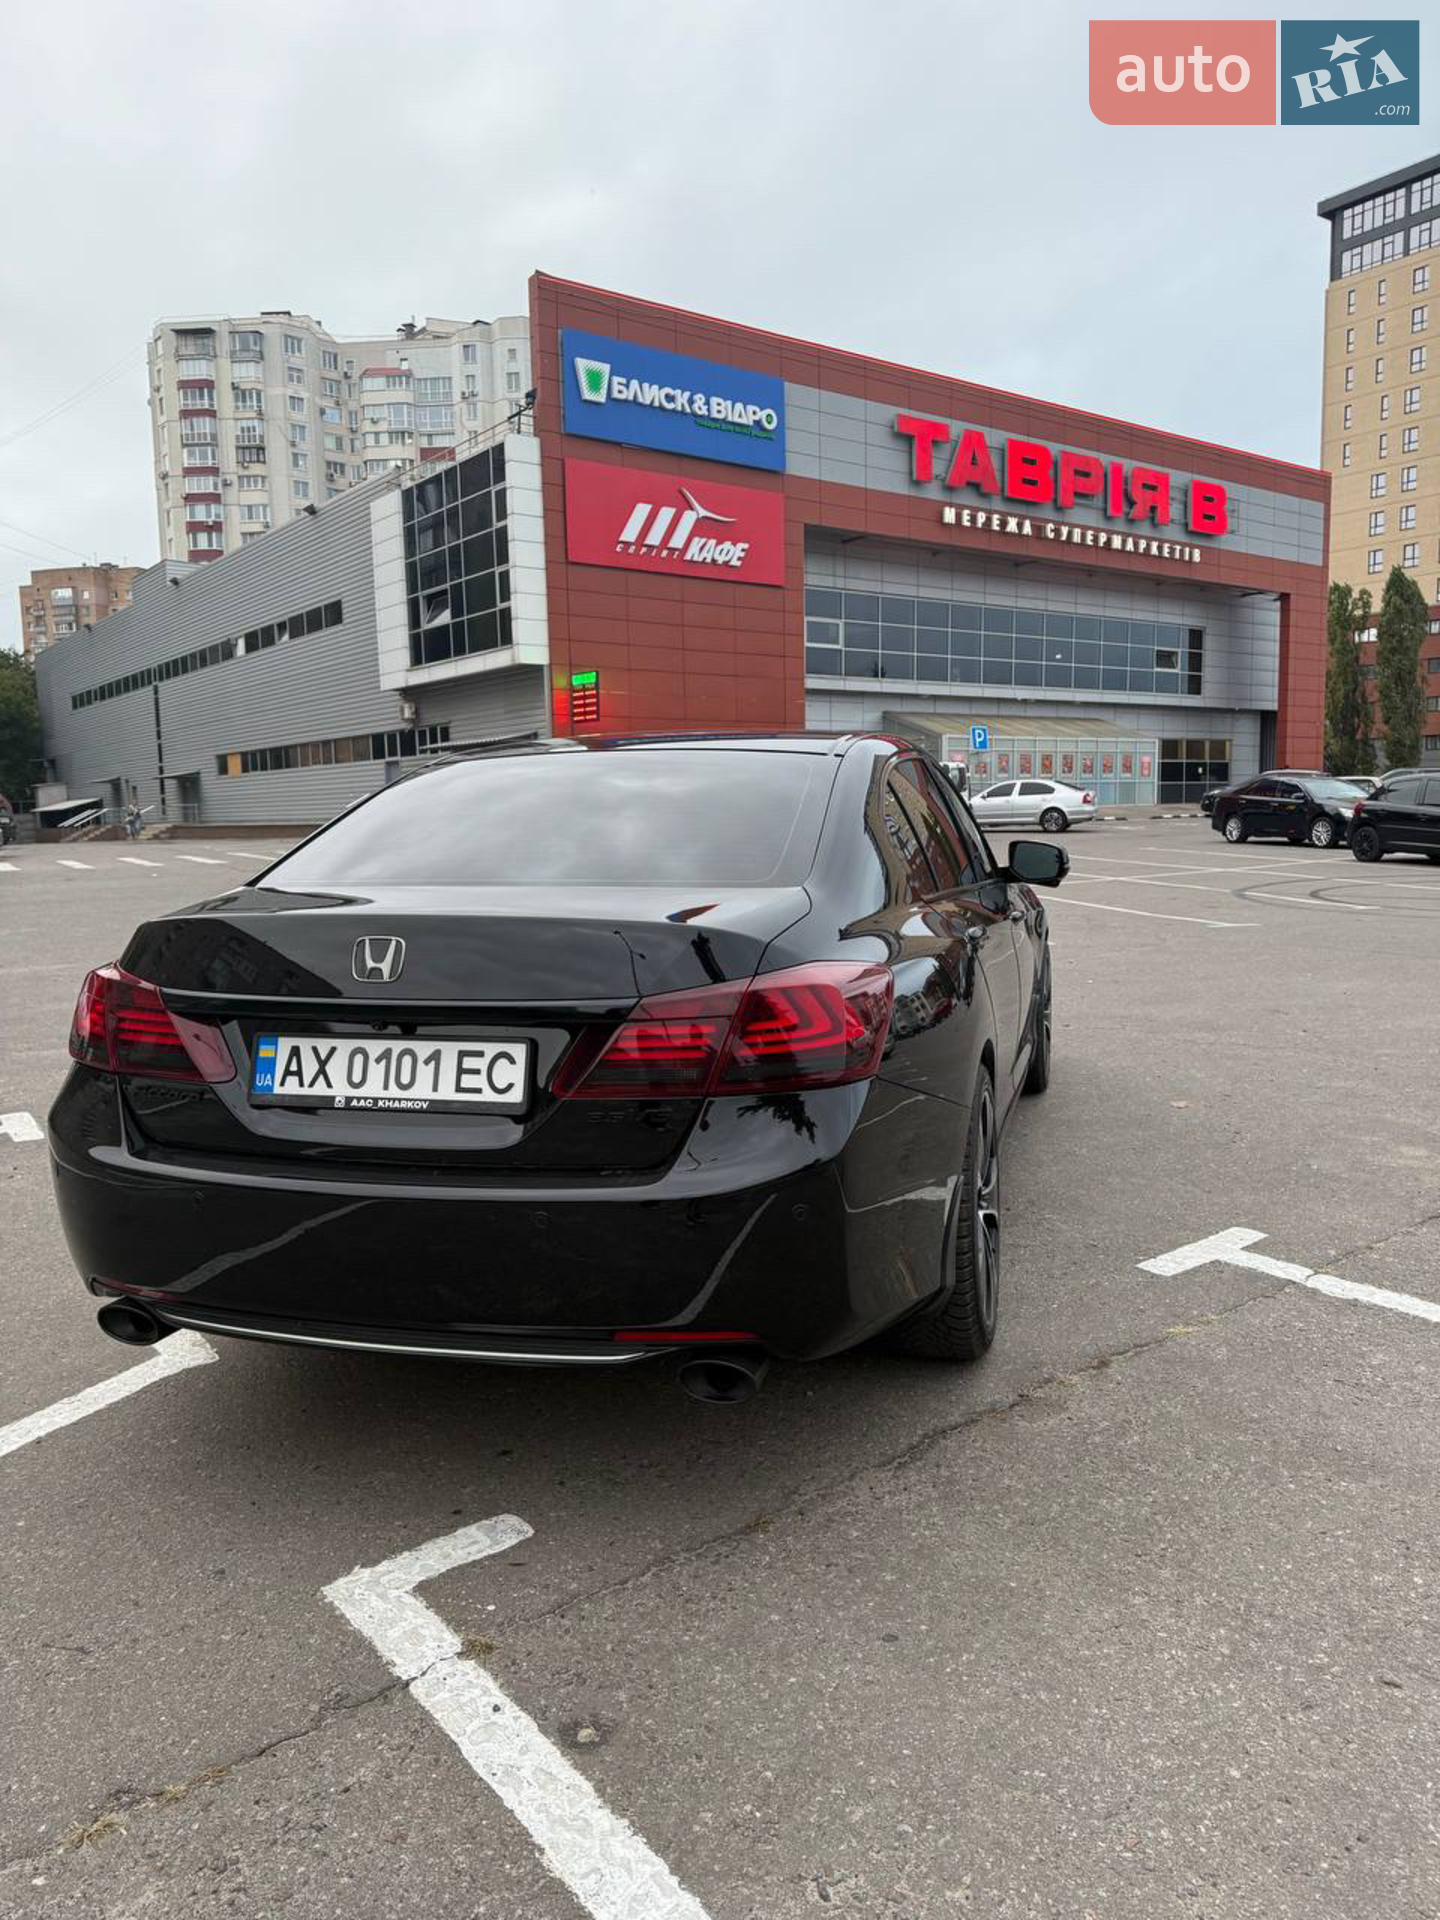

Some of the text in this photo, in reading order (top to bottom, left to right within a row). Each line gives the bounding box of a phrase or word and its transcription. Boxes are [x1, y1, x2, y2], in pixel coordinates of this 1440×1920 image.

[896, 413, 1229, 536] ТАВРІЯ В
[683, 536, 750, 567] КАФЕ
[943, 506, 1201, 564] МЕРЕЖА СУПЕРМАРКЕТІВ
[256, 1073, 273, 1087] UA
[279, 1045, 517, 1095] AX 0101 EC
[350, 1098, 430, 1109] AAC_KHARKOV
